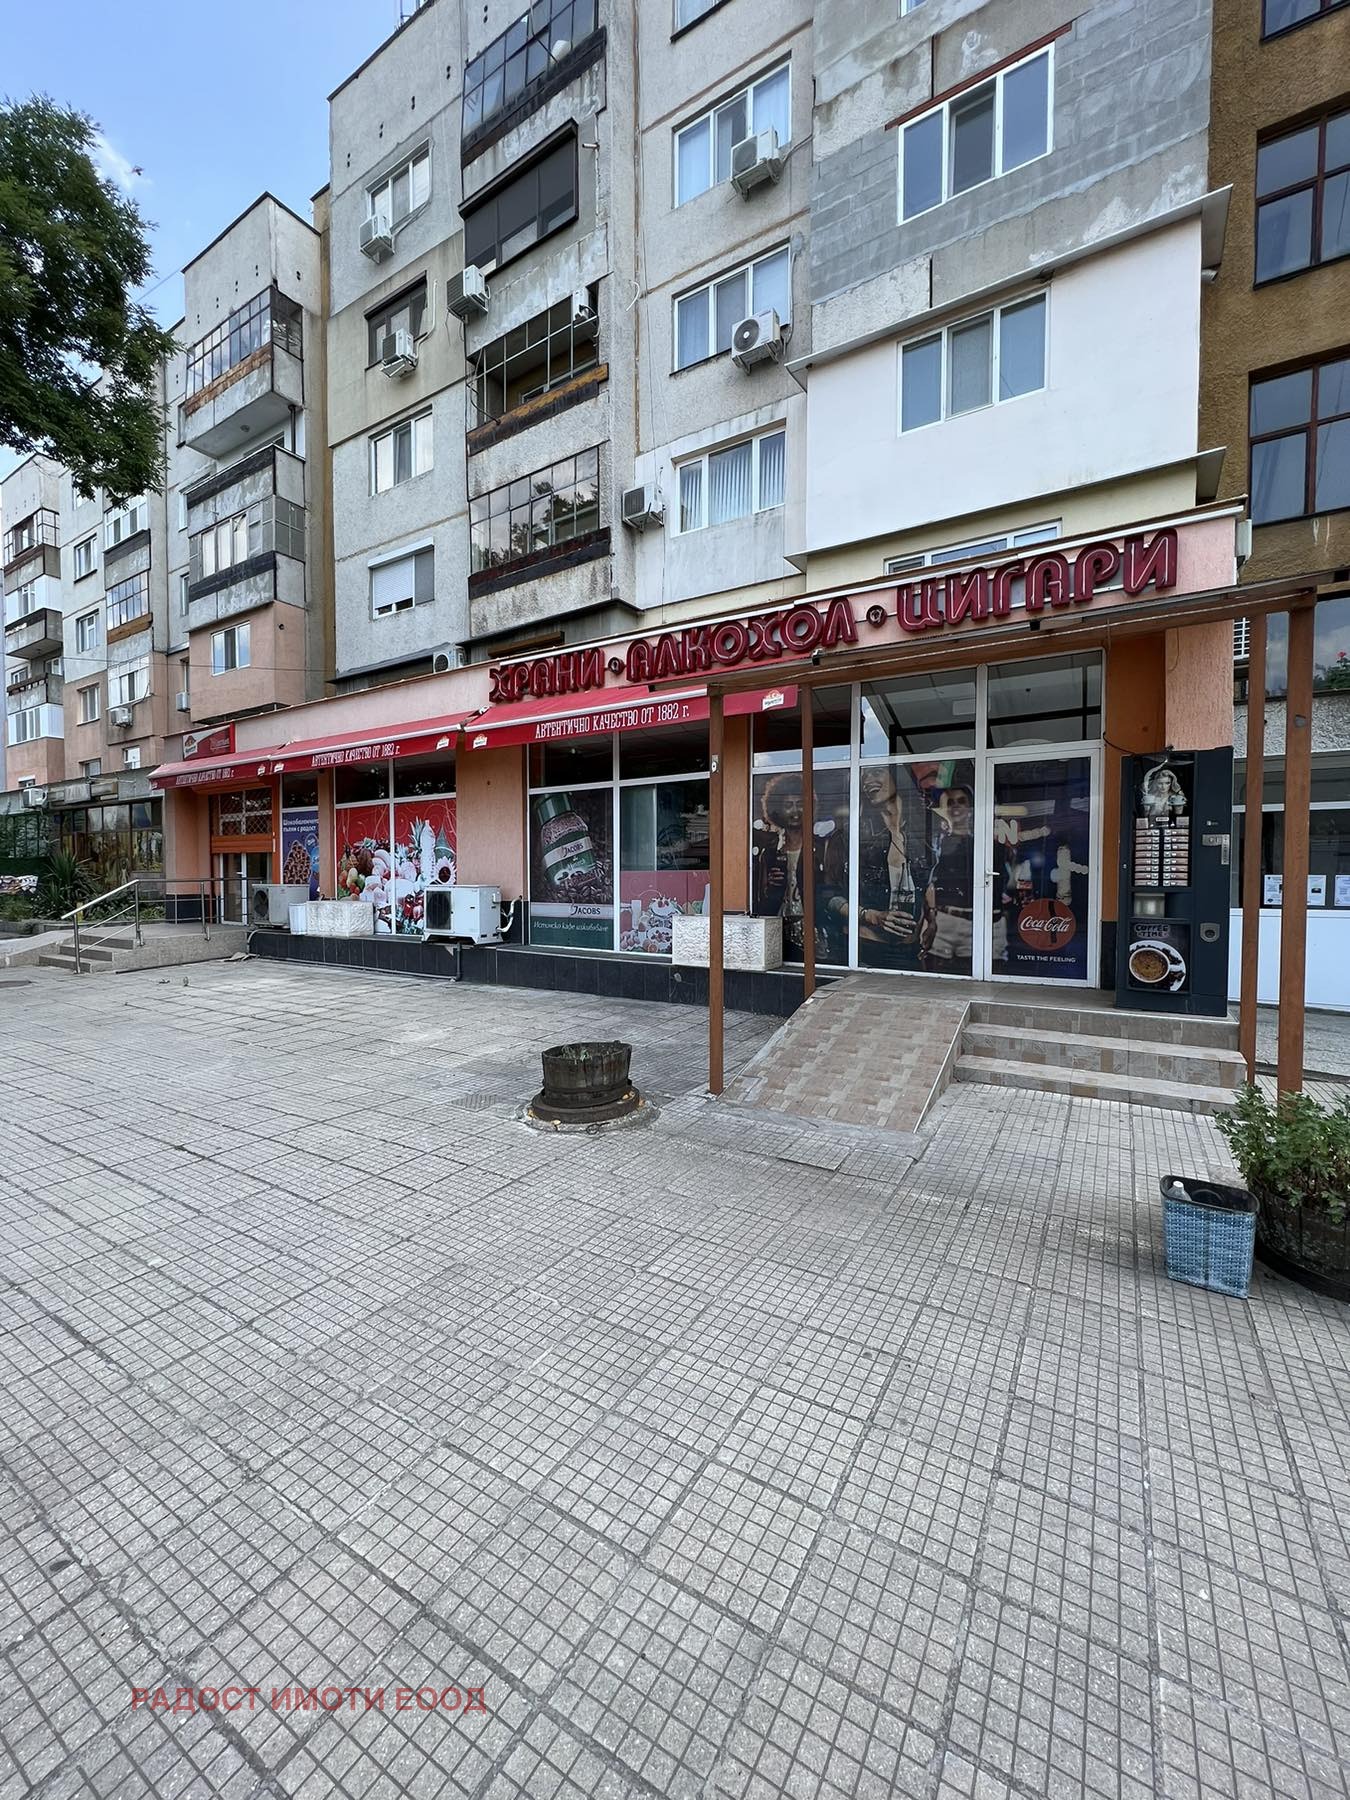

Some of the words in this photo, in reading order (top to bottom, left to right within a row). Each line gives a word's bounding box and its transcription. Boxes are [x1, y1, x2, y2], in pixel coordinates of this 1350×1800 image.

[489, 648, 605, 703] ХРАНИ
[626, 596, 858, 682] АЛКОХОЛ
[897, 528, 1178, 632] ЦИГАРИ
[535, 716, 590, 739] АВТЕНТИЧНО
[592, 709, 638, 731] КАЧЕСТВО
[641, 707, 654, 724] ОТ
[657, 702, 679, 722] 1882
[570, 905, 601, 915] JACOBS
[1020, 916, 1073, 932] Coca-Cola
